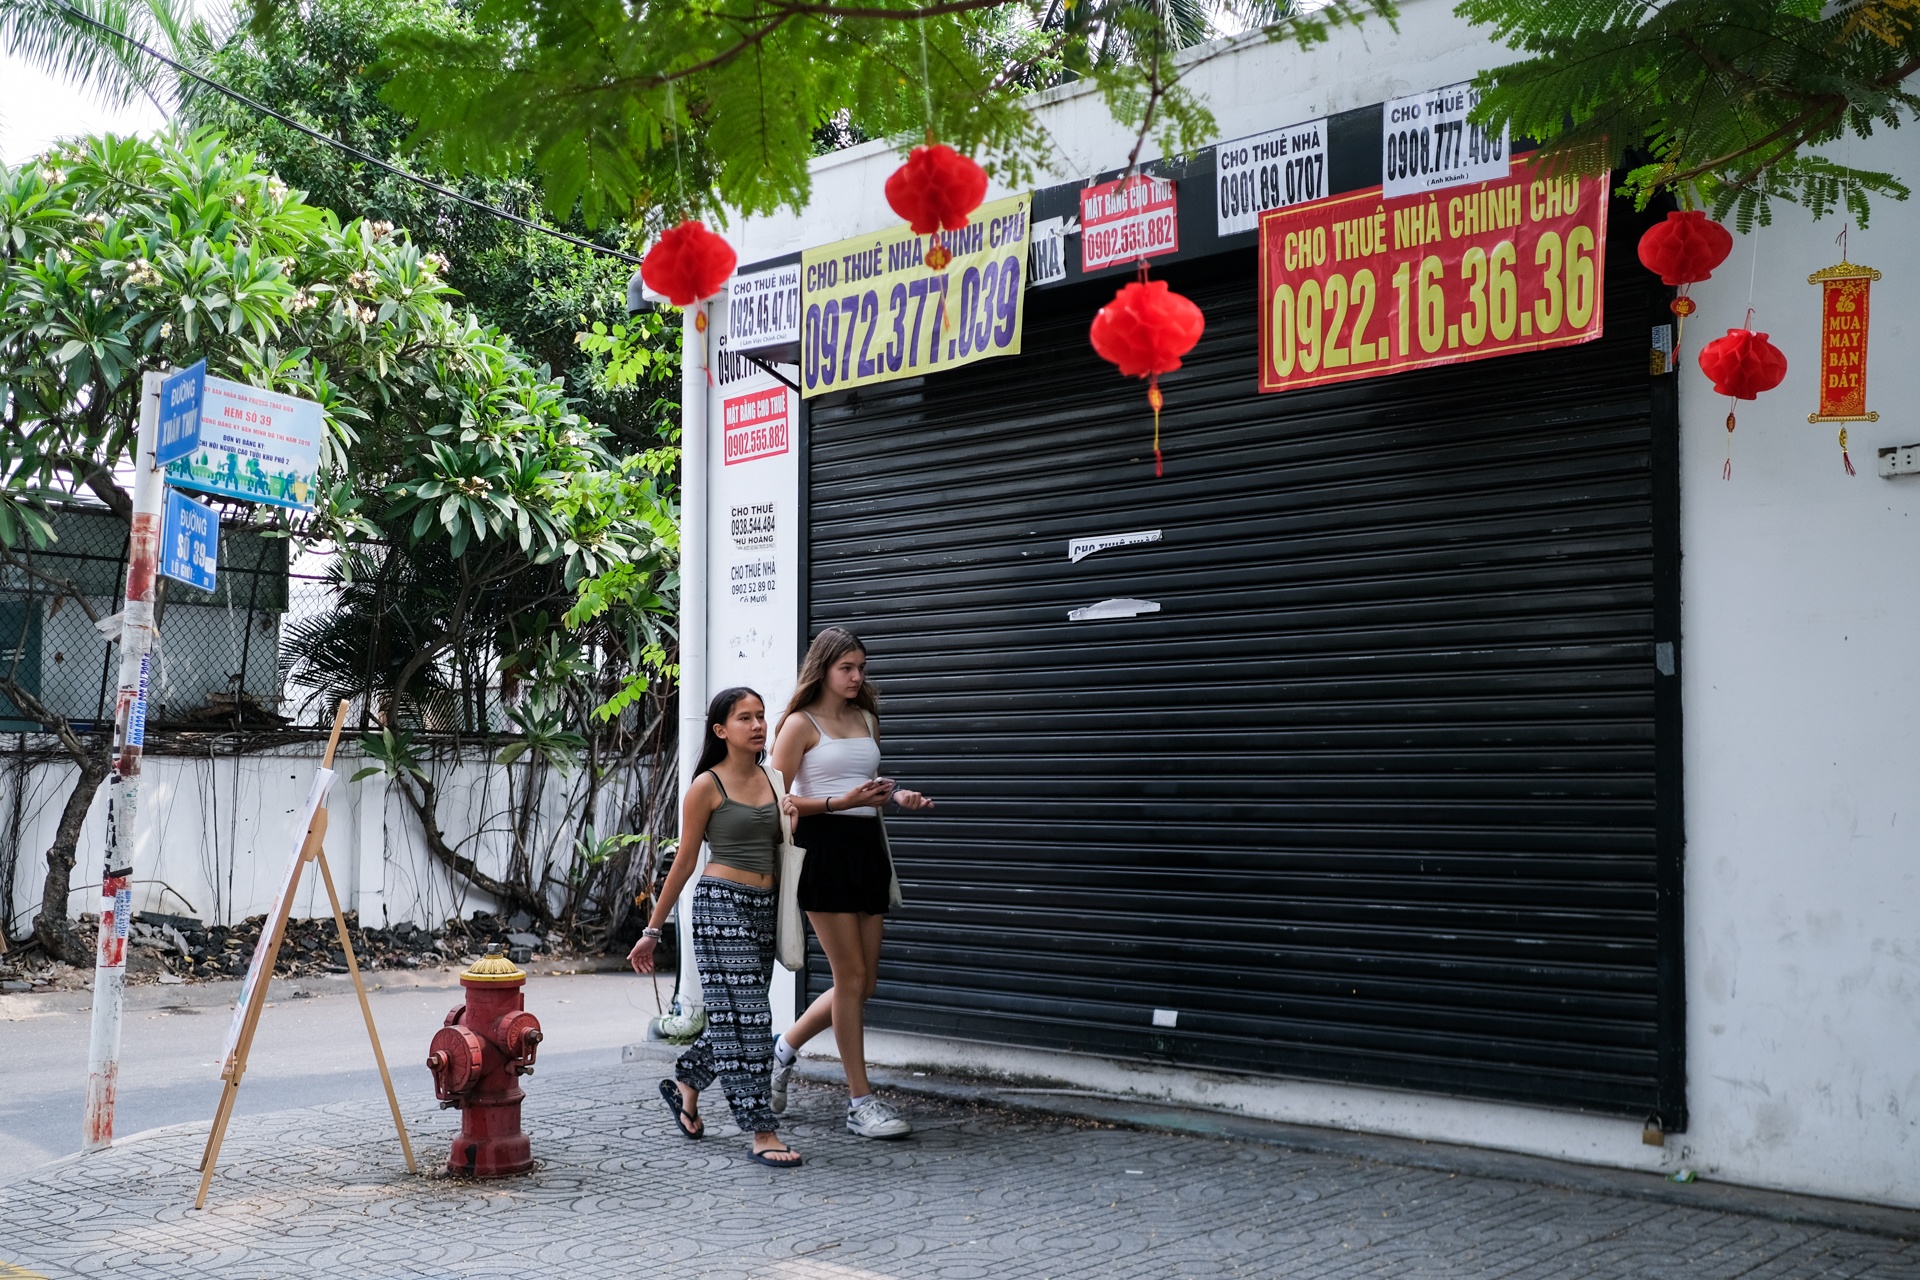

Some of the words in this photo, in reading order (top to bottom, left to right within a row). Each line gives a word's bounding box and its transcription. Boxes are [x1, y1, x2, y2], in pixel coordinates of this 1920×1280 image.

[1391, 104, 1421, 124] CHO
[1426, 90, 1464, 116] THUÊ
[1221, 147, 1248, 170] CHO
[1252, 133, 1288, 162] THUÊ
[1292, 125, 1320, 154] NHÀ
[1220, 152, 1324, 219] 0901.89.0707
[1084, 193, 1103, 223] MẶT
[1129, 183, 1148, 209] CHO
[1087, 214, 1173, 262] 0902.555.882
[1284, 225, 1326, 272] CHO
[1333, 205, 1387, 262] THUÊ
[1394, 193, 1442, 250] NHÀ
[1449, 182, 1522, 239] CHÍNH
[807, 259, 838, 293] CHO
[843, 241, 883, 284] THUÊ
[989, 201, 1026, 249] CHỦ
[734, 281, 752, 295] CHO
[754, 273, 776, 291] THUÊ
[779, 269, 797, 286] NHÀ
[730, 287, 798, 339] 0925.45.47.47
[1272, 225, 1595, 378] 0922.16.36.36
[805, 255, 1021, 390] 0972.377.039
[1829, 315, 1861, 331] MUA
[1829, 333, 1860, 348] MAY
[1829, 348, 1860, 367] BÁN
[171, 378, 195, 407] ĐƯỜNG
[1829, 366, 1859, 388] ĐẤT
[161, 412, 181, 447] XUÂN
[260, 415, 272, 426] 39
[237, 448, 248, 456] CAO
[728, 423, 785, 458] 0902.555.882
[180, 508, 207, 536] ĐƯỜNG
[731, 507, 749, 517] CHO
[751, 502, 774, 515] THUÊ
[177, 531, 191, 561] SỐ
[193, 540, 206, 567] 39
[733, 537, 746, 545] HÚ
[731, 565, 744, 580] CHO
[745, 558, 761, 579] THUÊ
[762, 555, 776, 576] NHÀ
[731, 583, 747, 595] 0902
[748, 582, 756, 593] 52
[757, 581, 766, 592] 89
[767, 580, 776, 591] 02
